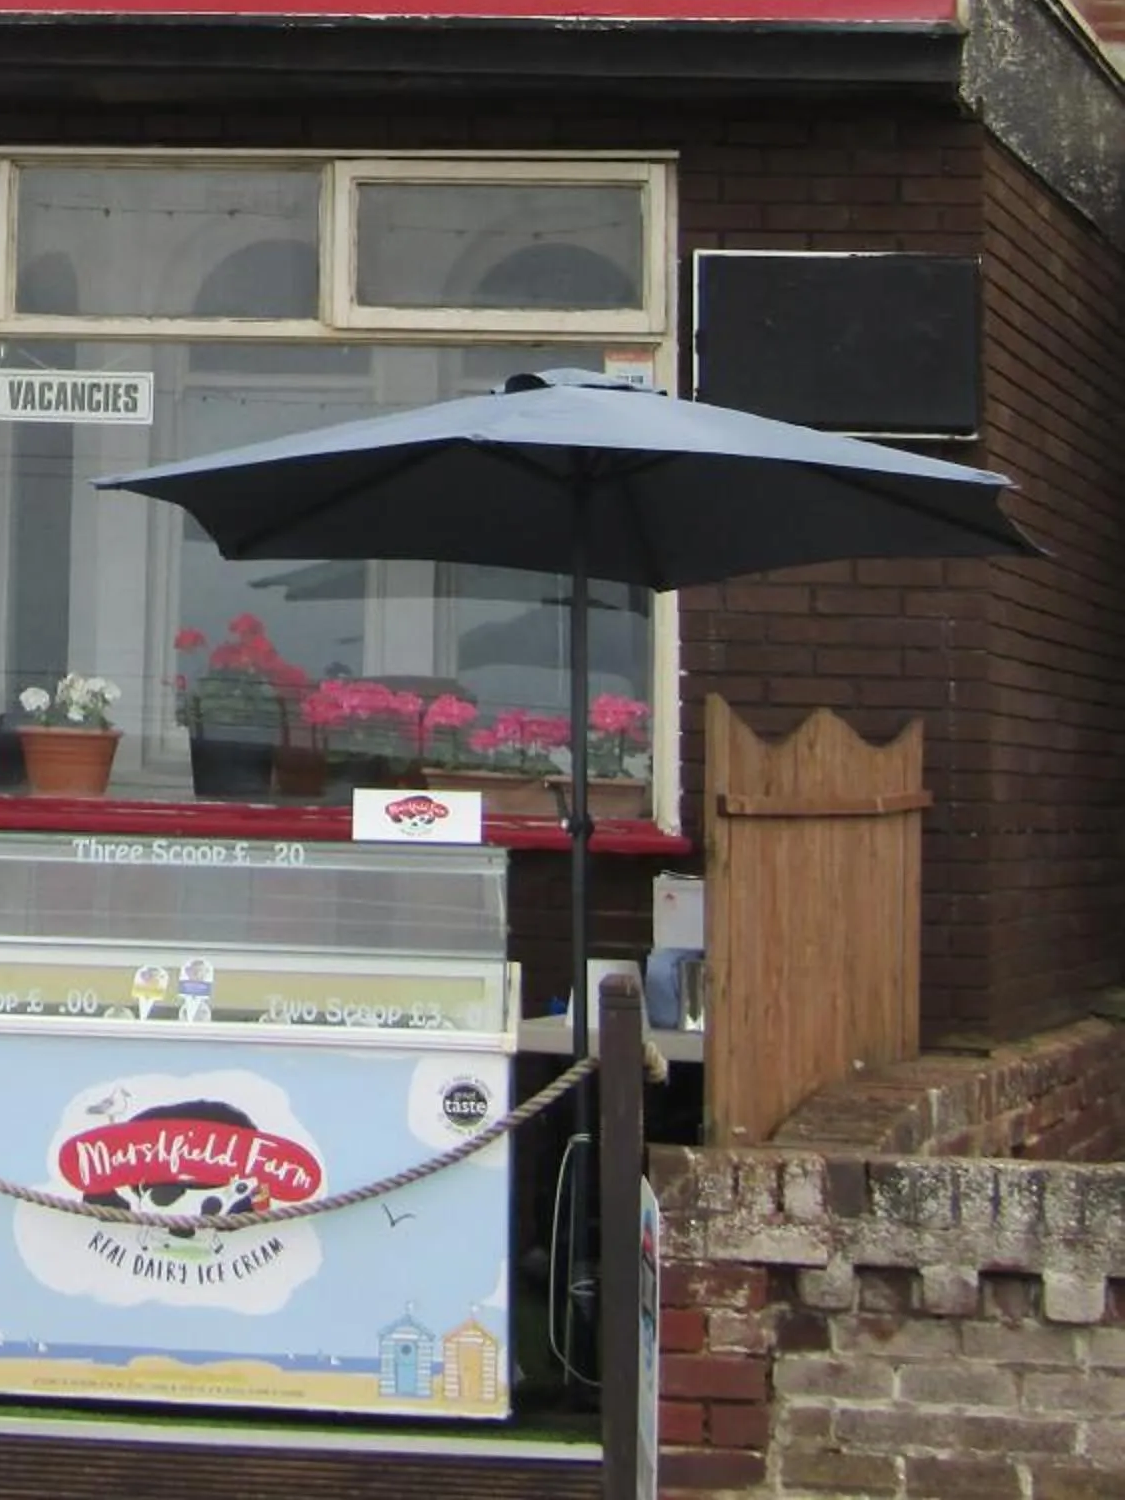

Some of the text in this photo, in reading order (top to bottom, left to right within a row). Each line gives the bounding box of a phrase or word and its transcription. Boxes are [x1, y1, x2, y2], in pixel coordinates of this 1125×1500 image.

[7, 379, 140, 414] VACANCIES
[72, 838, 144, 862] Three
[151, 839, 226, 866] Scoop
[445, 1099, 487, 1115] taste
[76, 1130, 312, 1190] Marshfield Farm
[88, 1231, 285, 1285] REAL DAIRY ICE CREAM
